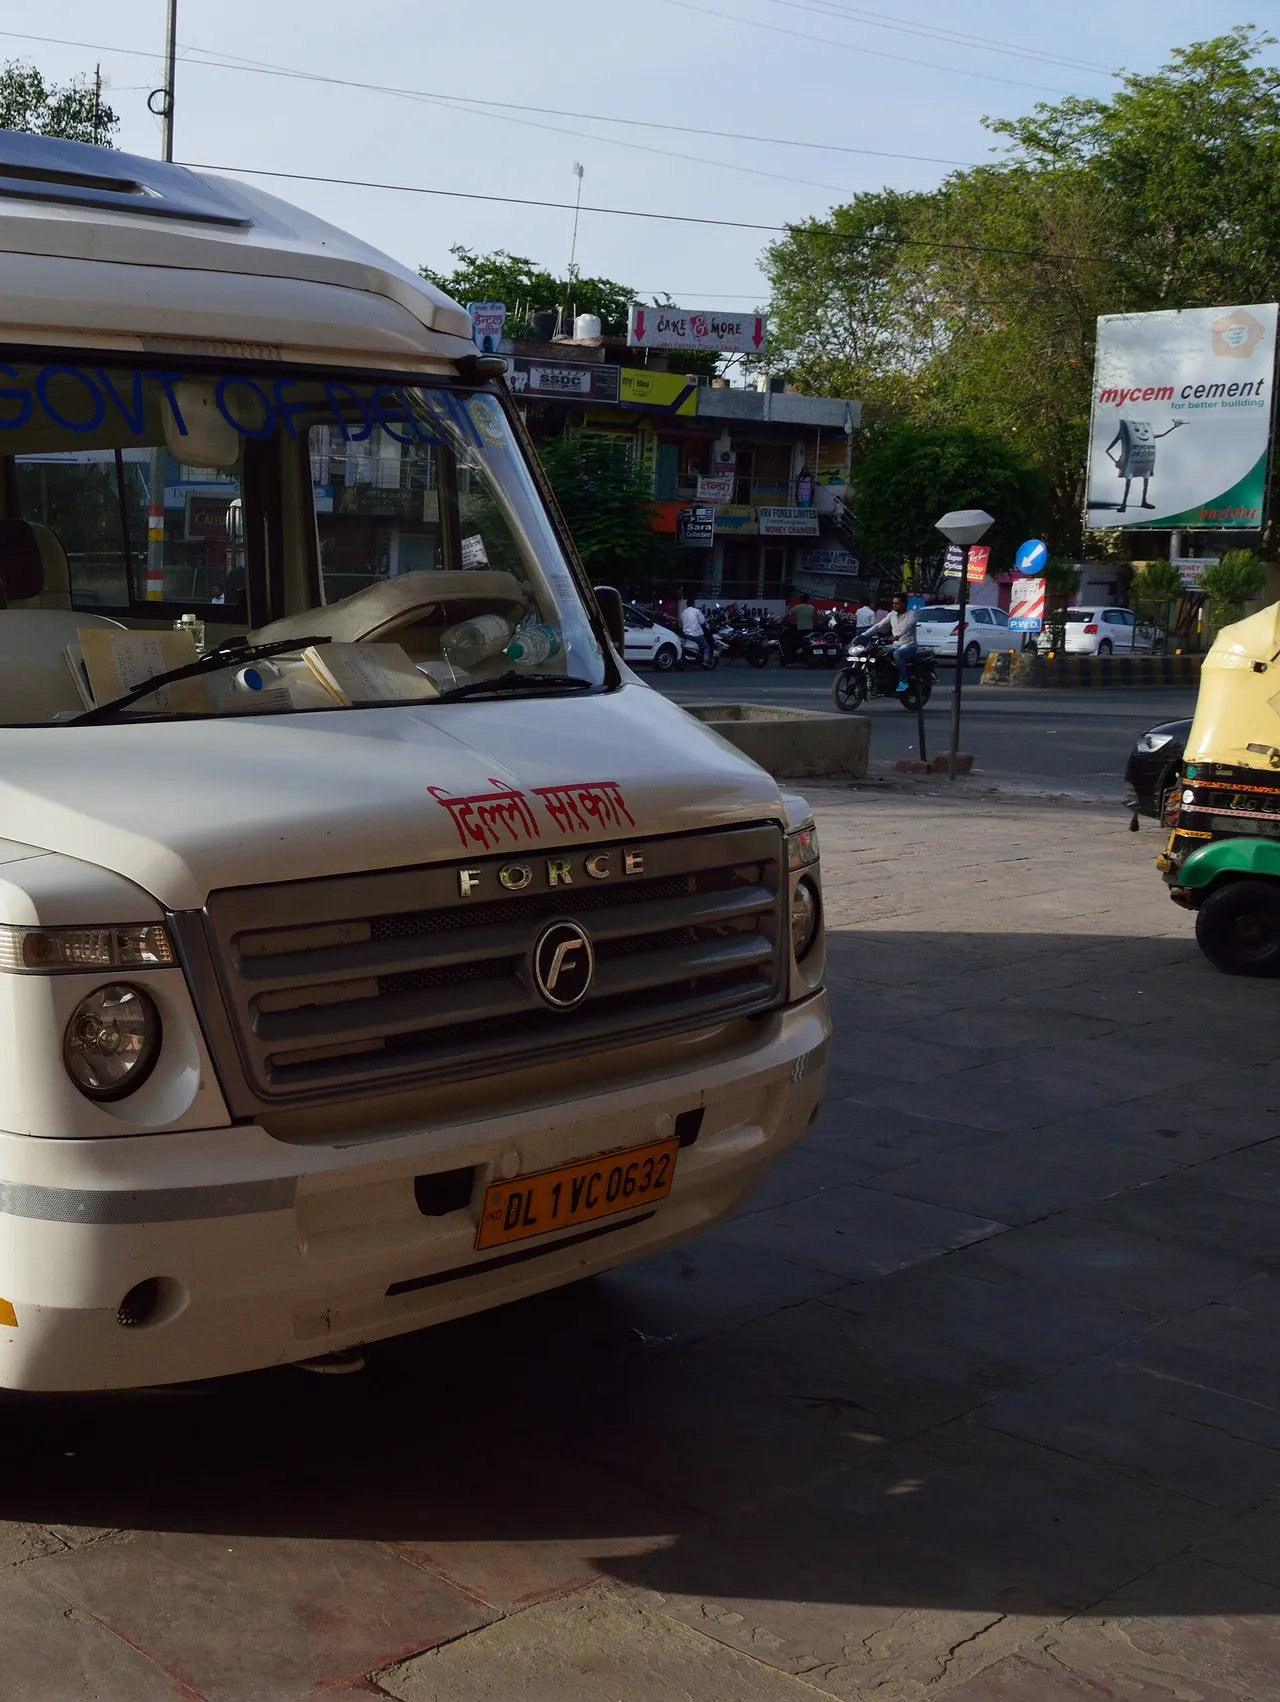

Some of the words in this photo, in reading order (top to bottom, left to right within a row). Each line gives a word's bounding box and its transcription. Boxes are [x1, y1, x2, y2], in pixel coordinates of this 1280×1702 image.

[657, 315, 687, 337] CAKE
[710, 317, 742, 339] MORE
[539, 374, 581, 386] SSDC
[622, 377, 633, 388] my
[1099, 386, 1176, 408] mycem
[1180, 377, 1265, 400] cement
[1171, 402, 1185, 410] for
[1188, 401, 1218, 409] better
[1221, 399, 1265, 408] building
[214, 375, 308, 440] OF
[323, 379, 484, 449] DELHI
[760, 508, 772, 518] VRV
[773, 508, 792, 519] FOREX
[793, 509, 817, 519] LIMITED
[686, 523, 712, 531] Sara
[764, 525, 787, 534] MONEY
[788, 526, 817, 535] CHANGER
[685, 531, 712, 539] Collection
[1010, 620, 1039, 629] P.W.D.
[426, 776, 541, 851] दिल्ली
[530, 780, 636, 834] सरकार
[456, 847, 645, 899] FORCE
[484, 1209, 503, 1223] IND
